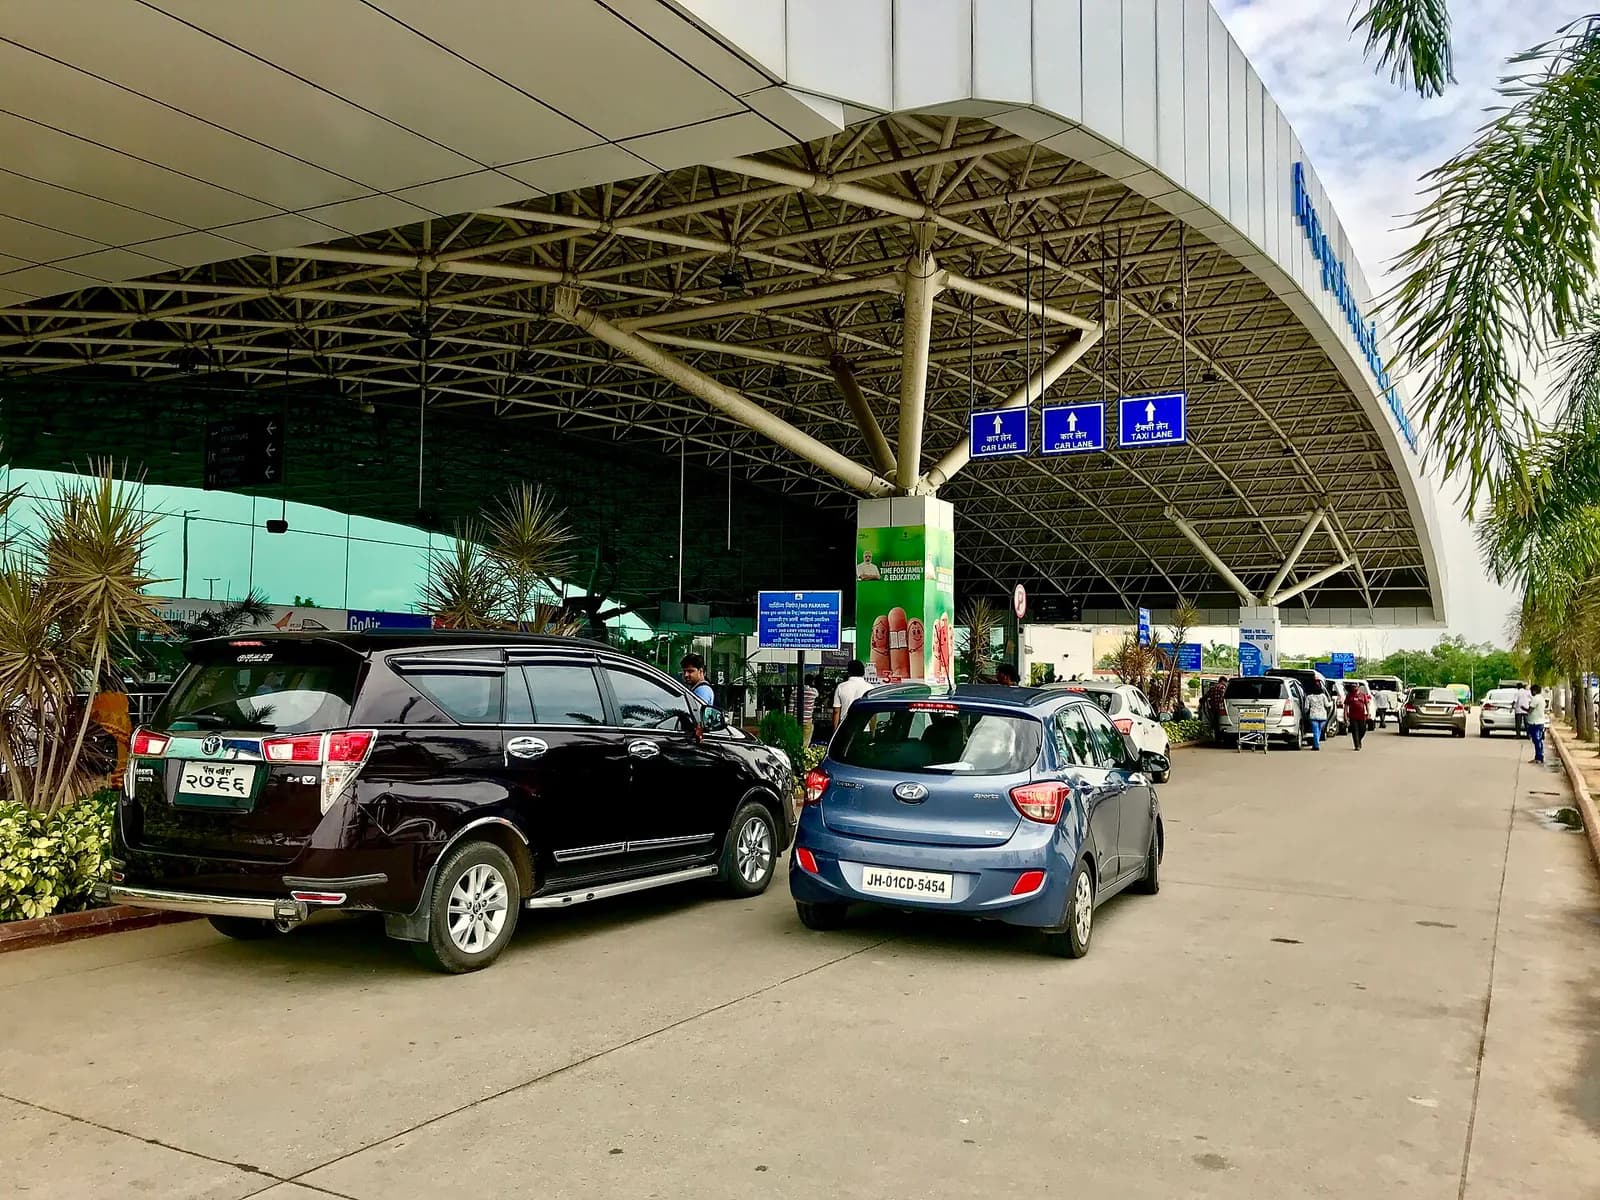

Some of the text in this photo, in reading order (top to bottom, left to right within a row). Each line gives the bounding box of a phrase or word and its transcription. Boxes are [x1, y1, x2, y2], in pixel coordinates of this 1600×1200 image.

[1156, 421, 1169, 430] लेन
[985, 433, 1012, 442] कार लेन
[1060, 431, 1087, 440] कार लेन
[1131, 430, 1173, 441] TAXI LANE
[981, 442, 1018, 452] CAR LANE
[1054, 440, 1094, 450] CAR LANE
[350, 616, 381, 631] GoAir
[866, 873, 946, 893] JH-01CD-5454
